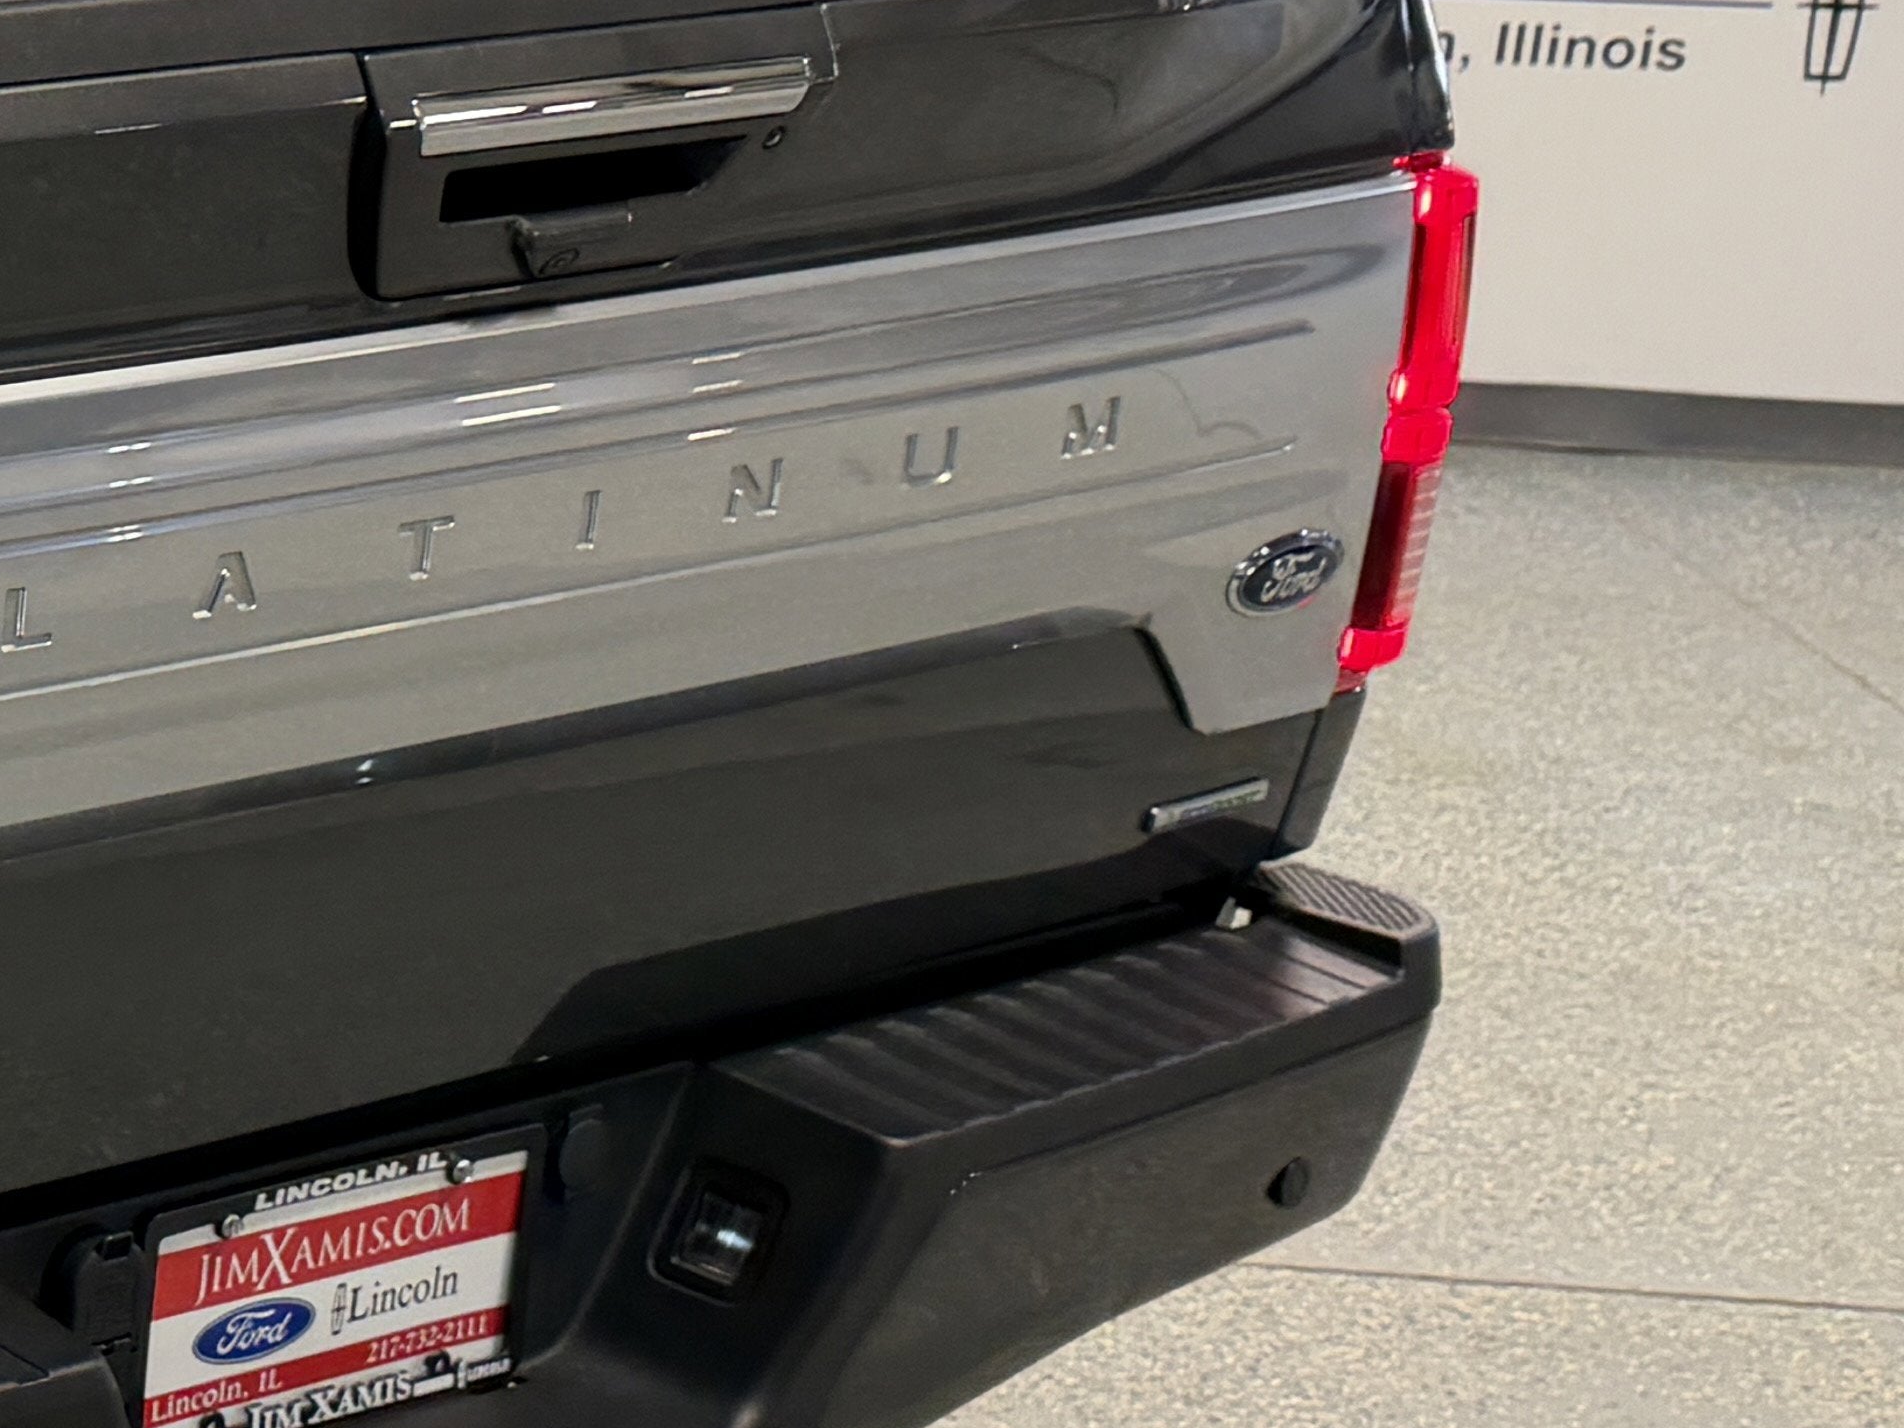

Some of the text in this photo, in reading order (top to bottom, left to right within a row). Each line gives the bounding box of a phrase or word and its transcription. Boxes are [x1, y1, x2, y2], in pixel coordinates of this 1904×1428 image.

[1494, 22, 1688, 73] Illinois
[1260, 551, 1327, 603] Ford
[418, 1151, 448, 1172] IL
[194, 1196, 471, 1307] JIMXAMIS.COM
[348, 1264, 459, 1324] Lincoln
[216, 1308, 289, 1356] Ford
[366, 1315, 489, 1364] 217-732-2111
[259, 1370, 283, 1393] IL
